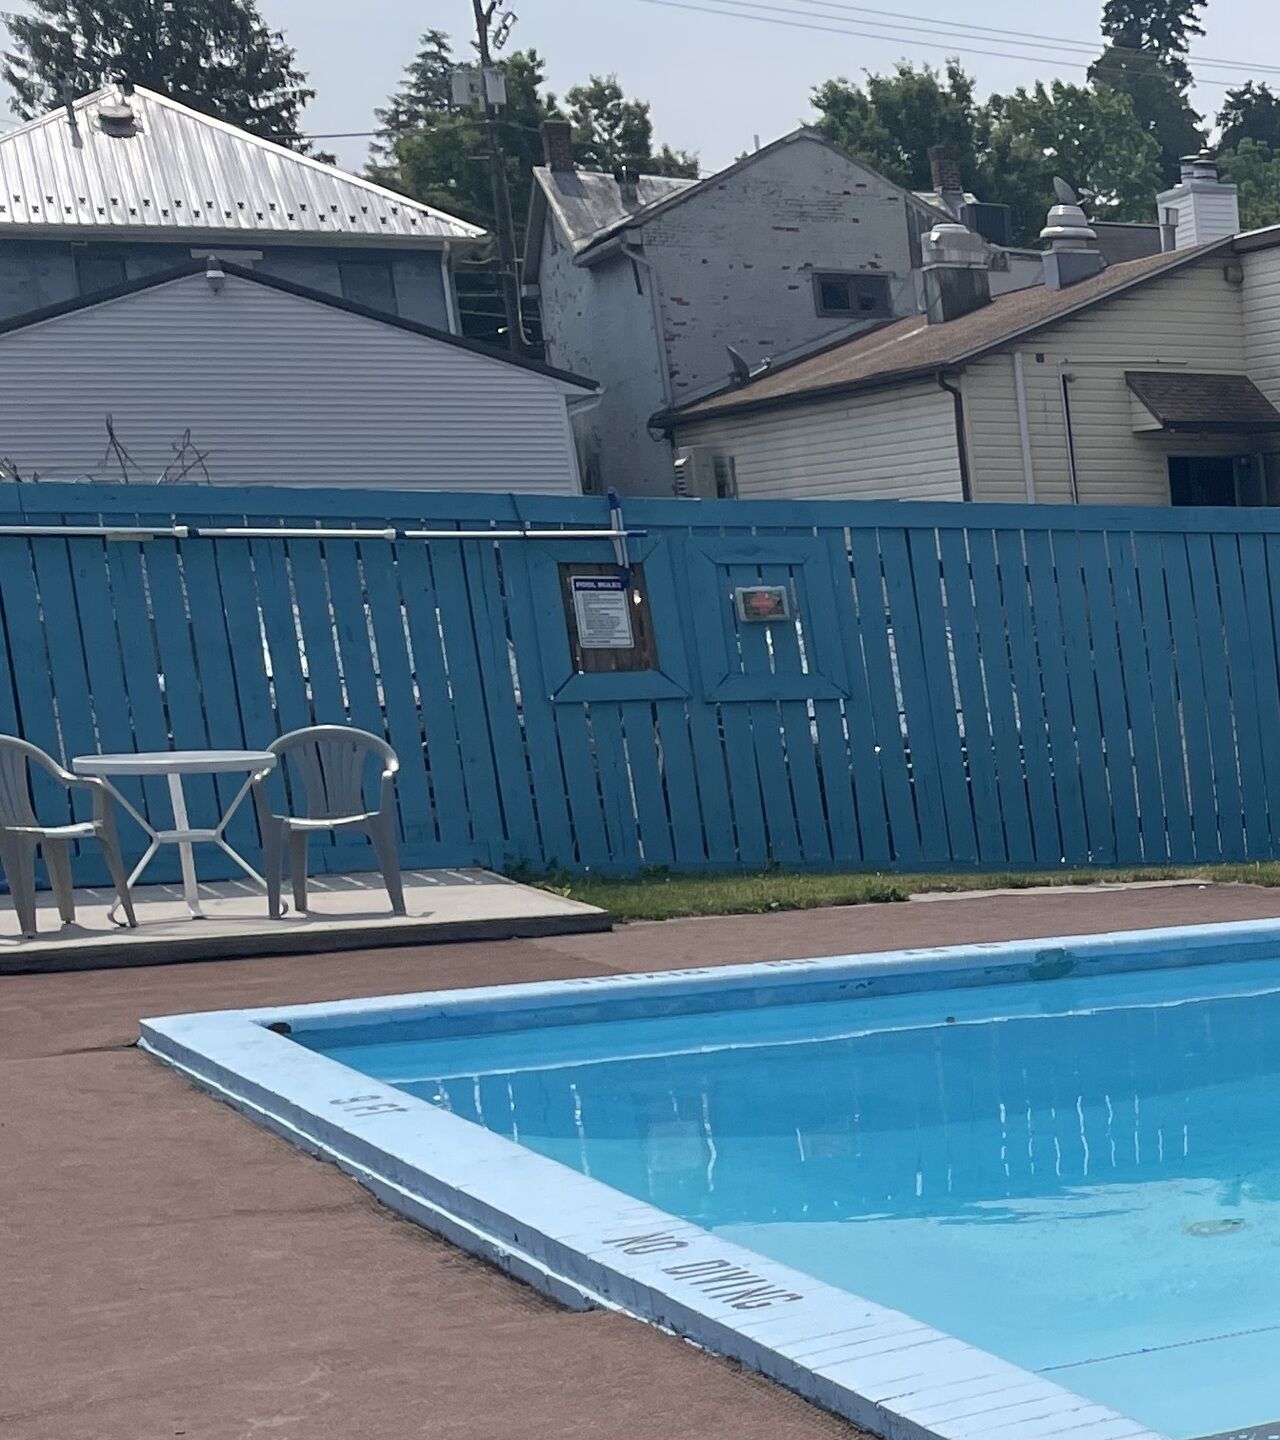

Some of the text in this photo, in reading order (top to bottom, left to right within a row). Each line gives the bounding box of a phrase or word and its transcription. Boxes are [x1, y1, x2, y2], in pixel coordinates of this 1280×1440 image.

[343, 1103, 409, 1118] FT
[601, 1231, 804, 1310] NO DIVING
